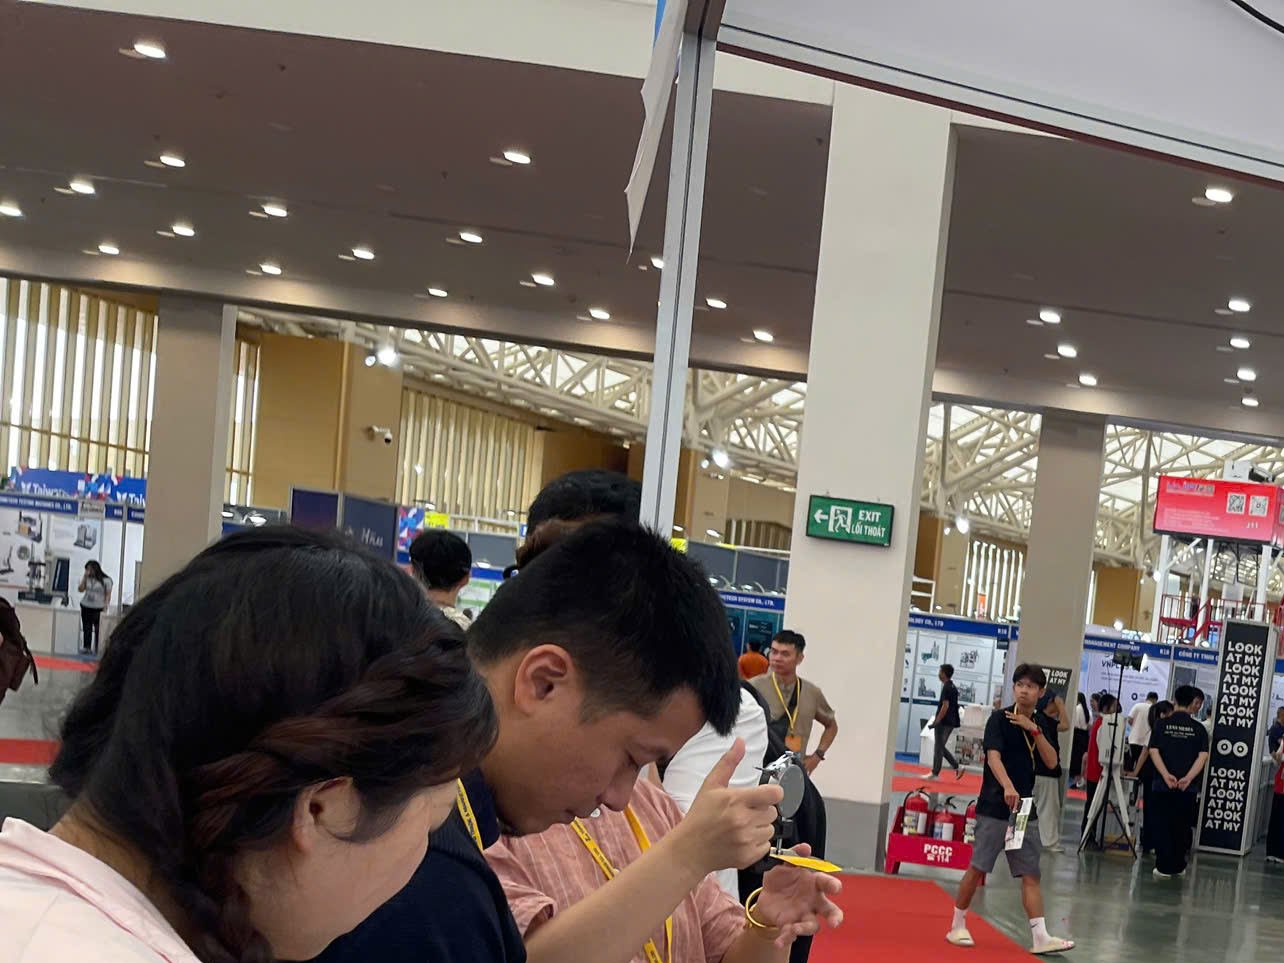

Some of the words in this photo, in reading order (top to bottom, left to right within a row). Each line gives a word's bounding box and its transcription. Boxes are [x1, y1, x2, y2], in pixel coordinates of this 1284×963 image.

[859, 510, 881, 523] EXIT
[851, 520, 863, 535] LỐI
[864, 522, 886, 538] THOÁT
[1227, 641, 1263, 655] LOOK
[1226, 652, 1242, 662] AT
[1244, 655, 1262, 665] MY
[1051, 669, 1068, 678] LOOK
[1225, 662, 1261, 676] LOOK
[1058, 678, 1067, 686] MY
[1223, 673, 1239, 683] AT
[1241, 676, 1259, 686] MY
[1222, 683, 1257, 697] LOOK
[1220, 694, 1237, 704] AT
[1239, 697, 1257, 707] MY
[1220, 704, 1255, 718] LOOK
[1218, 715, 1234, 725] AT
[1236, 718, 1254, 728] MY
[1210, 766, 1245, 780] LOOK
[1210, 778, 1226, 788] AT
[1229, 780, 1246, 790] MY
[1209, 787, 1244, 801] LOOK
[1207, 798, 1224, 808] AT
[1226, 801, 1243, 811] MY
[1207, 808, 1241, 821] LOOK
[1205, 819, 1221, 829] AT
[1223, 821, 1240, 832] MY
[923, 843, 953, 856] PCCC
[936, 855, 949, 863] 114
